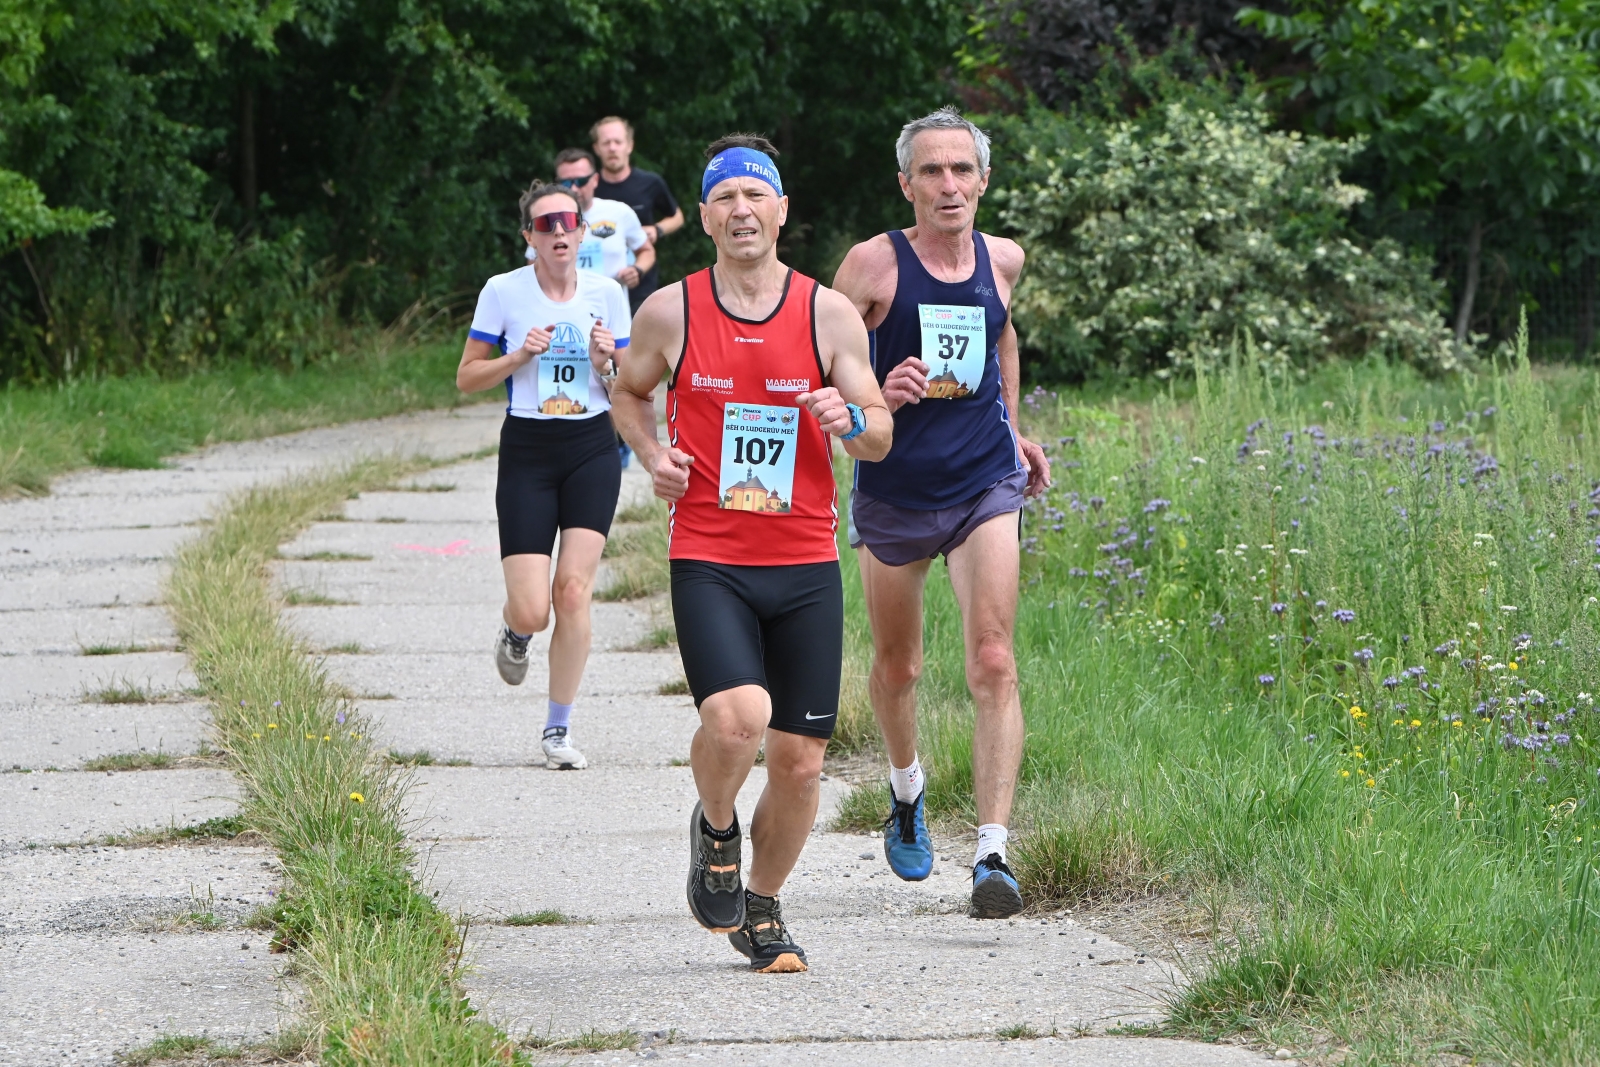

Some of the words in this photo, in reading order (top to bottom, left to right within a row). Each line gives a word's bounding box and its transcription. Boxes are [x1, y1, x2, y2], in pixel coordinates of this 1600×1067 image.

[579, 255, 592, 268] 71
[938, 333, 970, 361] 37
[553, 364, 575, 383] 10
[691, 373, 734, 389] Krakonoš
[766, 378, 810, 386] MARATON
[742, 413, 762, 422] CUP
[725, 423, 739, 431] BĚH
[781, 427, 795, 435] MEČ
[733, 436, 785, 466] 107
